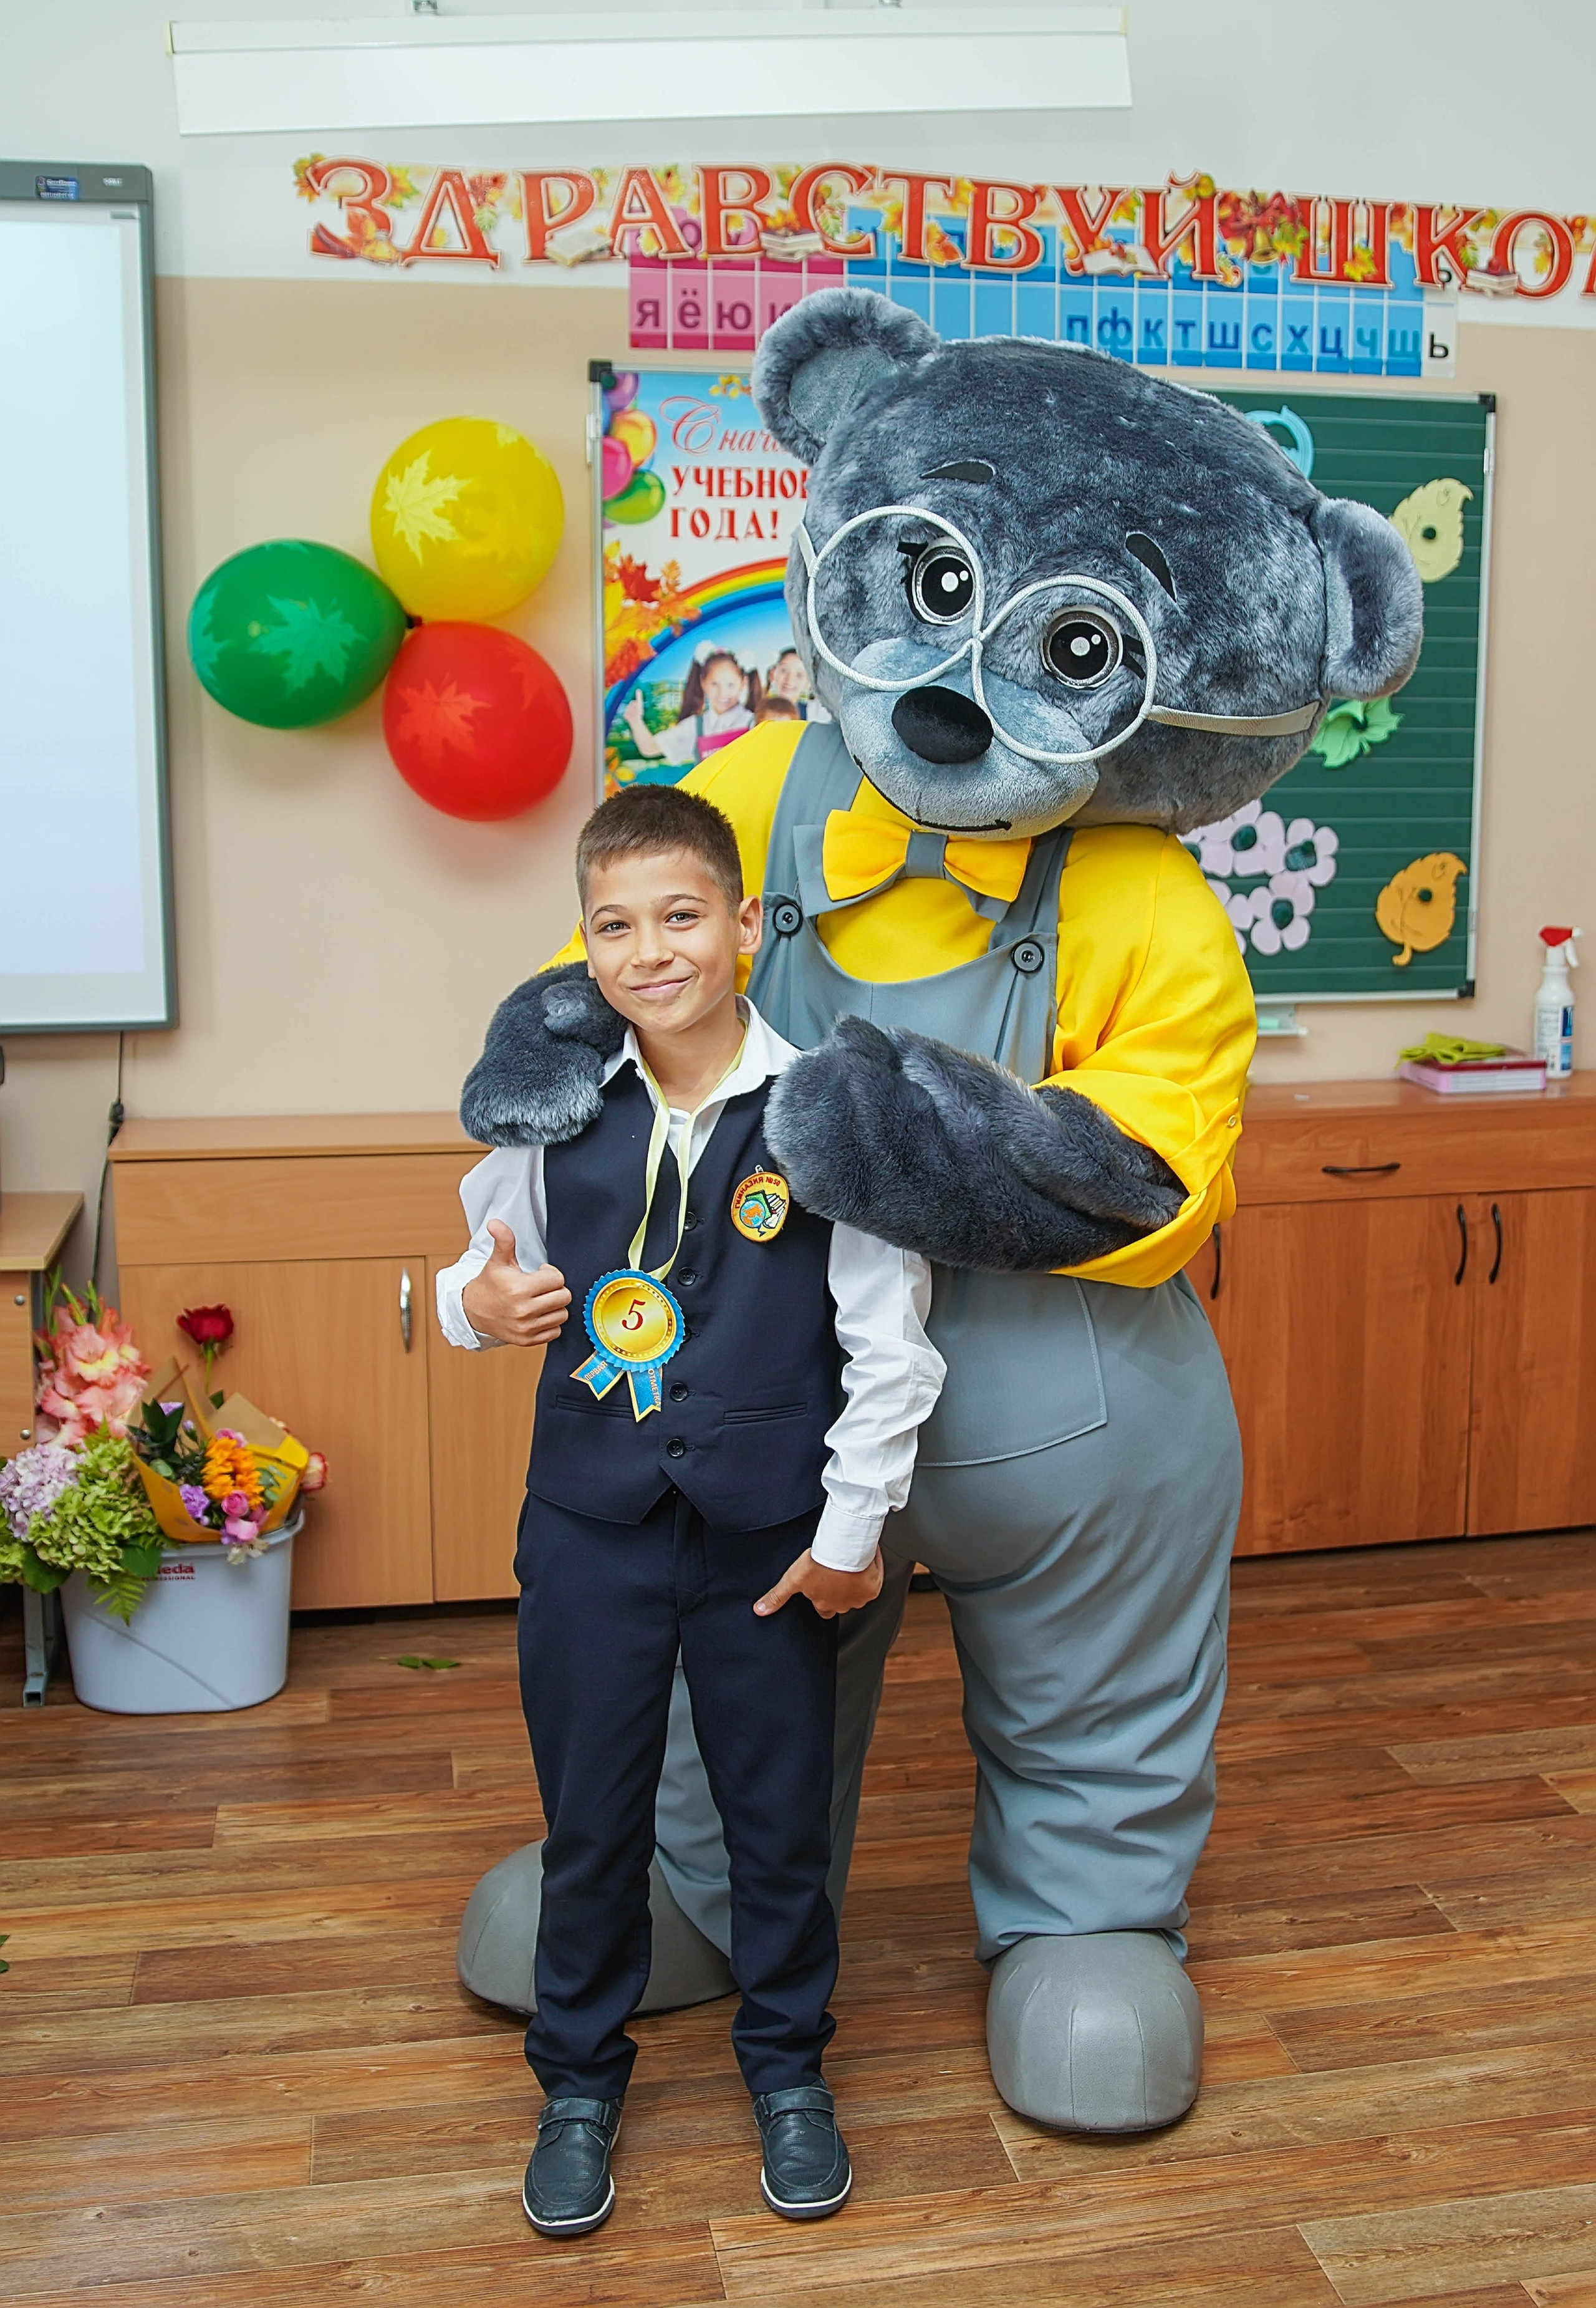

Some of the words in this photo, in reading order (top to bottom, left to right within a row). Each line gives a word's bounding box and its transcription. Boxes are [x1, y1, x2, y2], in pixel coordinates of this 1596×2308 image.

[659, 395, 721, 456] С
[670, 507, 779, 541] ГОДА!
[735, 1177, 763, 1209] ГИМНАЗИЯ
[621, 1299, 645, 1330] 5
[584, 1360, 608, 1381] ПЕРВАЯ
[648, 1369, 661, 1407] ОТМЕТКА
